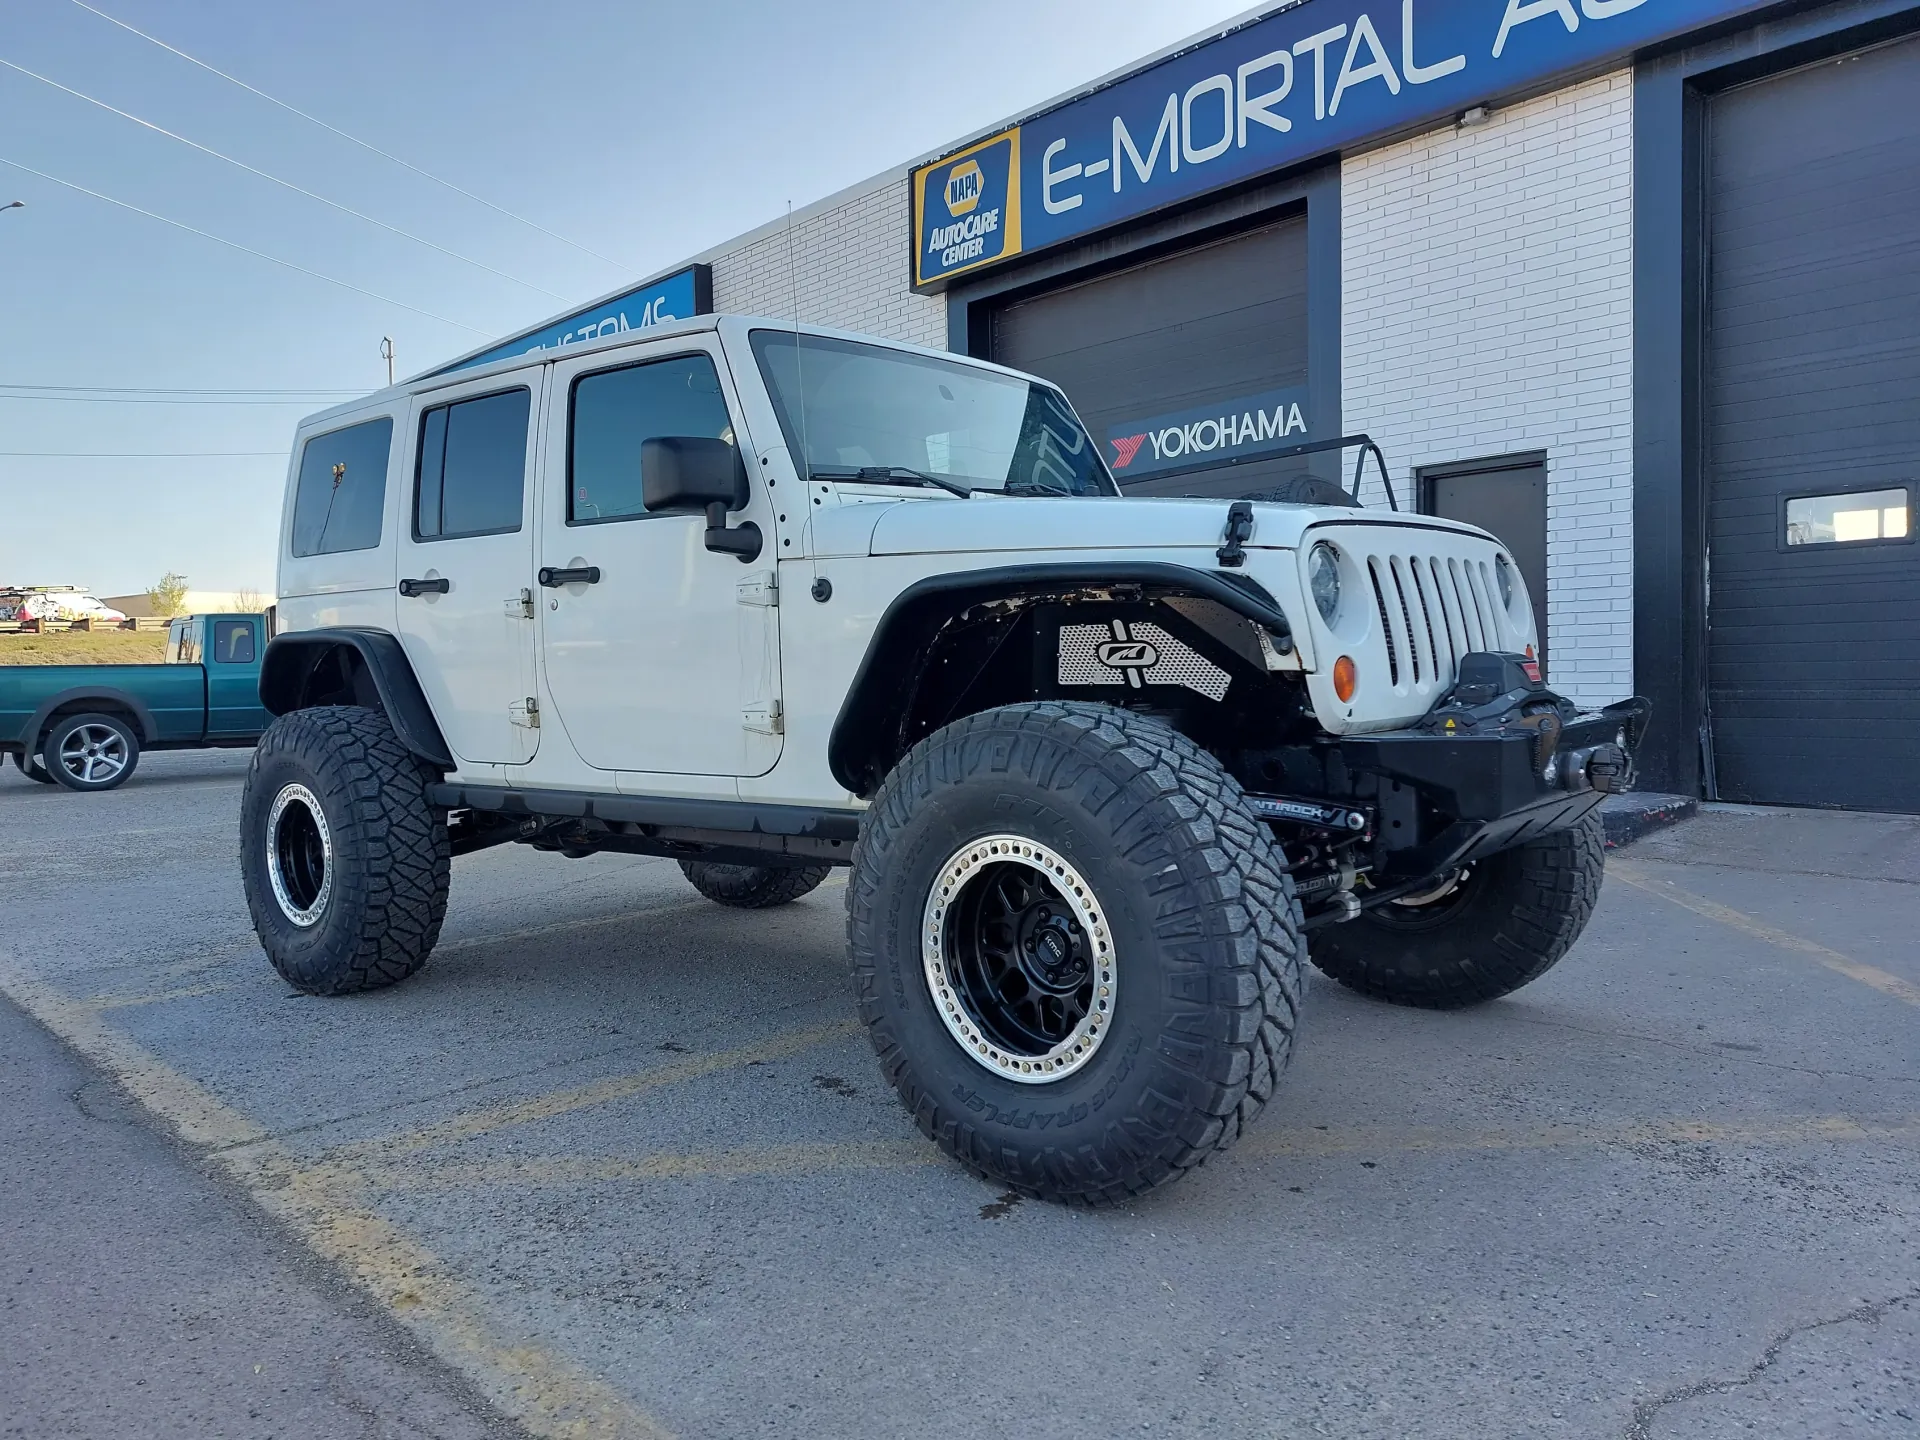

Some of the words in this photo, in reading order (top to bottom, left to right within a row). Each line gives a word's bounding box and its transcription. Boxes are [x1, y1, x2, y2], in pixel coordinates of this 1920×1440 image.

[1042, 0, 1466, 215] E-MORTAL
[950, 172, 978, 205] NAPA
[942, 236, 983, 267] CENTER
[1149, 402, 1307, 460] YOKOHAMA
[952, 1083, 1088, 1130] GRAPPLER
